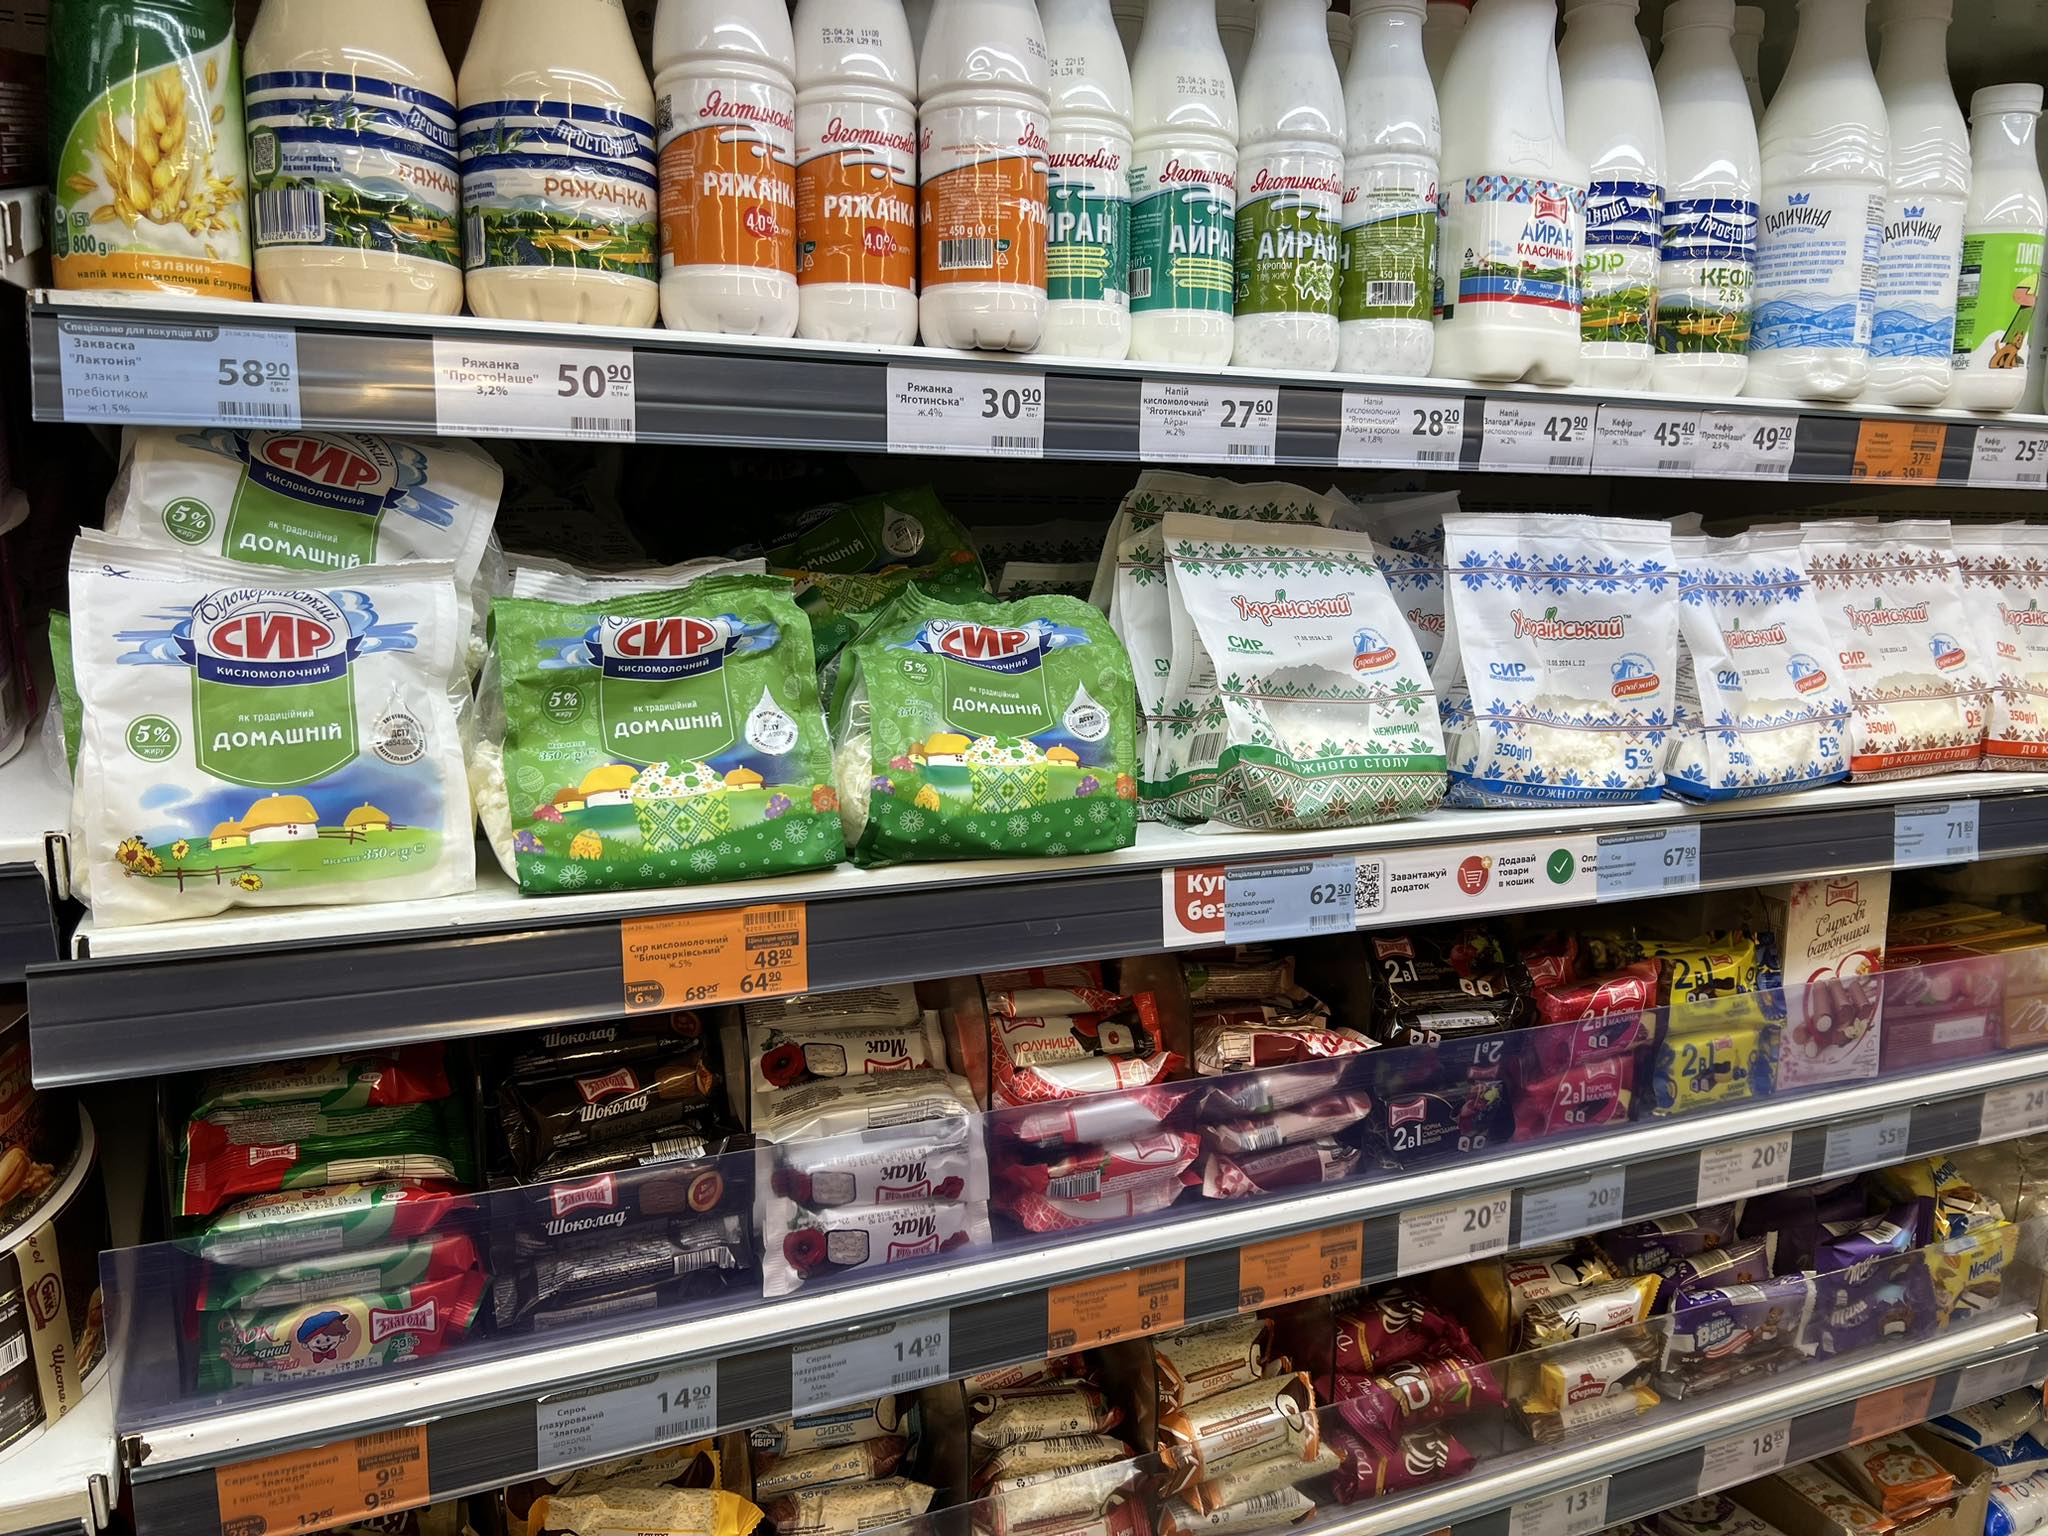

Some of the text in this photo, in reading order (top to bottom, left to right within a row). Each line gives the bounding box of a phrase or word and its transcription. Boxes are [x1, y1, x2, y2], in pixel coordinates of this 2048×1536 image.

[544, 176, 650, 210] РЯЖАНКА
[1764, 207, 1832, 234] ГАЛИЧИНА
[73, 234, 97, 254] 800
[1257, 223, 1339, 262] АЙРАН
[1521, 223, 1575, 250] АЙРАН
[64, 322, 214, 340] Спеціально для покупців АТБ
[74, 338, 136, 352] Закваска
[69, 353, 143, 367] "Лактонія"
[461, 357, 520, 371] Ряжанка
[218, 358, 290, 387] 58 90
[443, 369, 540, 385] "ПростоНаше"
[557, 363, 607, 399] 50
[607, 364, 632, 381] 90
[68, 386, 149, 400] пребіотиком
[476, 385, 509, 397] 3,2%
[907, 382, 954, 395] Ряжанка
[1165, 387, 1189, 396] Напій
[896, 394, 965, 406] "Яготинська"
[981, 388, 1042, 419] 30 90
[1143, 397, 1209, 407] кисломолочний
[1363, 397, 1384, 406] Напій
[1163, 416, 1188, 427] Айран
[1220, 400, 1273, 429] 27 60
[1412, 409, 1460, 437] 28 20
[1499, 409, 1519, 418] Напій
[1345, 426, 1368, 436] Айран
[1514, 419, 1536, 429] Айран
[1543, 416, 1588, 443] 42 90
[1612, 418, 1633, 429] Кефір
[1714, 422, 1734, 432] Кефір
[1653, 422, 1696, 447] 45 40
[1752, 427, 1793, 451] 49 70
[2014, 440, 2037, 463] 25
[265, 438, 380, 489] СИР
[265, 472, 367, 507] КИСЛОМОЛОЧНИЙ
[269, 522, 340, 544] як традиційний
[1231, 592, 1353, 626] Український
[1510, 608, 1625, 640] Український
[1844, 602, 1929, 636] Український
[213, 614, 333, 660] СИР
[617, 617, 715, 657] СИР
[938, 626, 1026, 660] СИР
[1227, 636, 1264, 653] СИР
[618, 656, 711, 674] КИСЛОМОЛОЧНИЙ
[1839, 651, 1866, 665] СИР
[216, 663, 332, 682] КИСЛОМОЛОЧНИЙ
[1489, 662, 1526, 678] СИР
[239, 709, 315, 724] як традиційний
[952, 697, 1041, 717] ДОМАШНІЙ
[614, 711, 724, 740] ДОМАШНІЙ
[1373, 722, 1421, 737] НЕЖИРНИЙ
[212, 725, 344, 753] ДОМАШНІЙ
[1882, 756, 1895, 767] ДО
[1896, 752, 1943, 766] КОЖНОГО
[2021, 745, 2039, 756] ДО
[1365, 755, 1410, 770] СТОЛУ
[1502, 783, 1640, 801] ДО КОЖНОГО СТОЛУ
[1947, 821, 1962, 839] 71
[1498, 854, 1537, 868] Додавай
[1663, 847, 1697, 867] 67 90
[1390, 868, 1447, 883] Завантажуй
[1498, 867, 1529, 879] товари
[1498, 876, 1535, 889] в кошик
[1243, 890, 1256, 900] Сир
[1310, 883, 1352, 905] 62 30
[1390, 881, 1430, 895] додаток
[630, 944, 649, 955] Сир
[651, 935, 730, 953] кисломолочний
[634, 947, 726, 963] "Білоцерківський"
[754, 950, 780, 969] 48
[740, 972, 769, 994] 64
[685, 985, 707, 1001] 68
[866, 1038, 908, 1059] Мак
[1013, 1036, 1076, 1054] ПОЛУНИЦЯ
[1877, 1129, 1896, 1146] 55
[1752, 1146, 1775, 1170] 20
[881, 1160, 926, 1183] Мак
[1588, 1191, 1608, 1209] 20
[891, 1214, 936, 1238] Мак
[1462, 1200, 1507, 1233] 20 70
[1322, 1274, 1331, 1289] 8
[1141, 1315, 1152, 1331] 8
[893, 1336, 925, 1363] 14
[657, 1385, 712, 1414] 14 90
[556, 1405, 587, 1419] Сирок
[539, 1411, 605, 1433] глазурований
[1752, 1433, 1773, 1457] 18
[376, 1469, 389, 1488] 9
[364, 1492, 380, 1513] 9
[1564, 1490, 1588, 1515] 13
